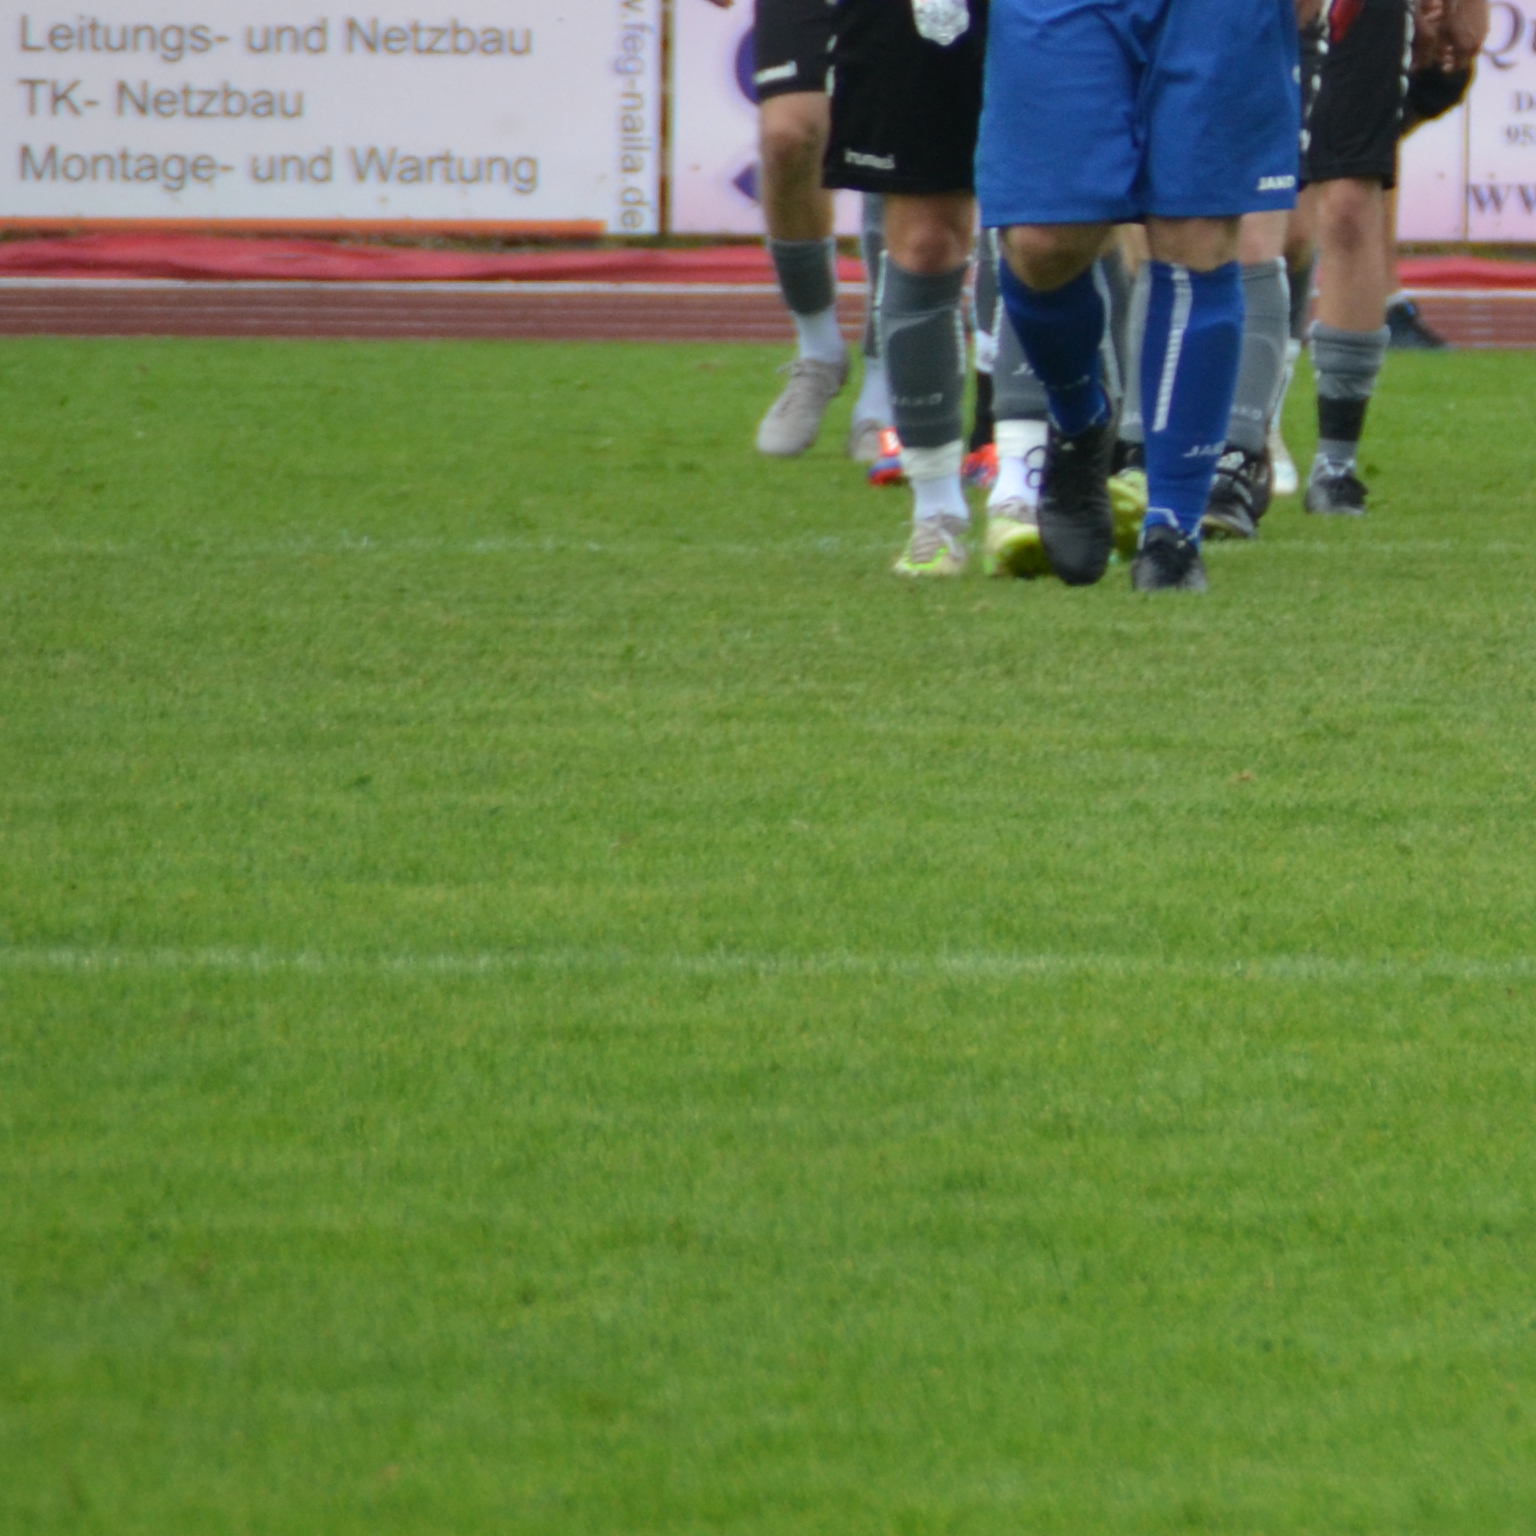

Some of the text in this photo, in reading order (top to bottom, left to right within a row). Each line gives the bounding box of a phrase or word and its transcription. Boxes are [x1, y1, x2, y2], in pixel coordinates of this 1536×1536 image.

[20, 15, 532, 62] Leitungs- und Netzbau
[20, 81, 303, 119] TK- Netzbau
[20, 145, 539, 195] Montage- und Wartung
